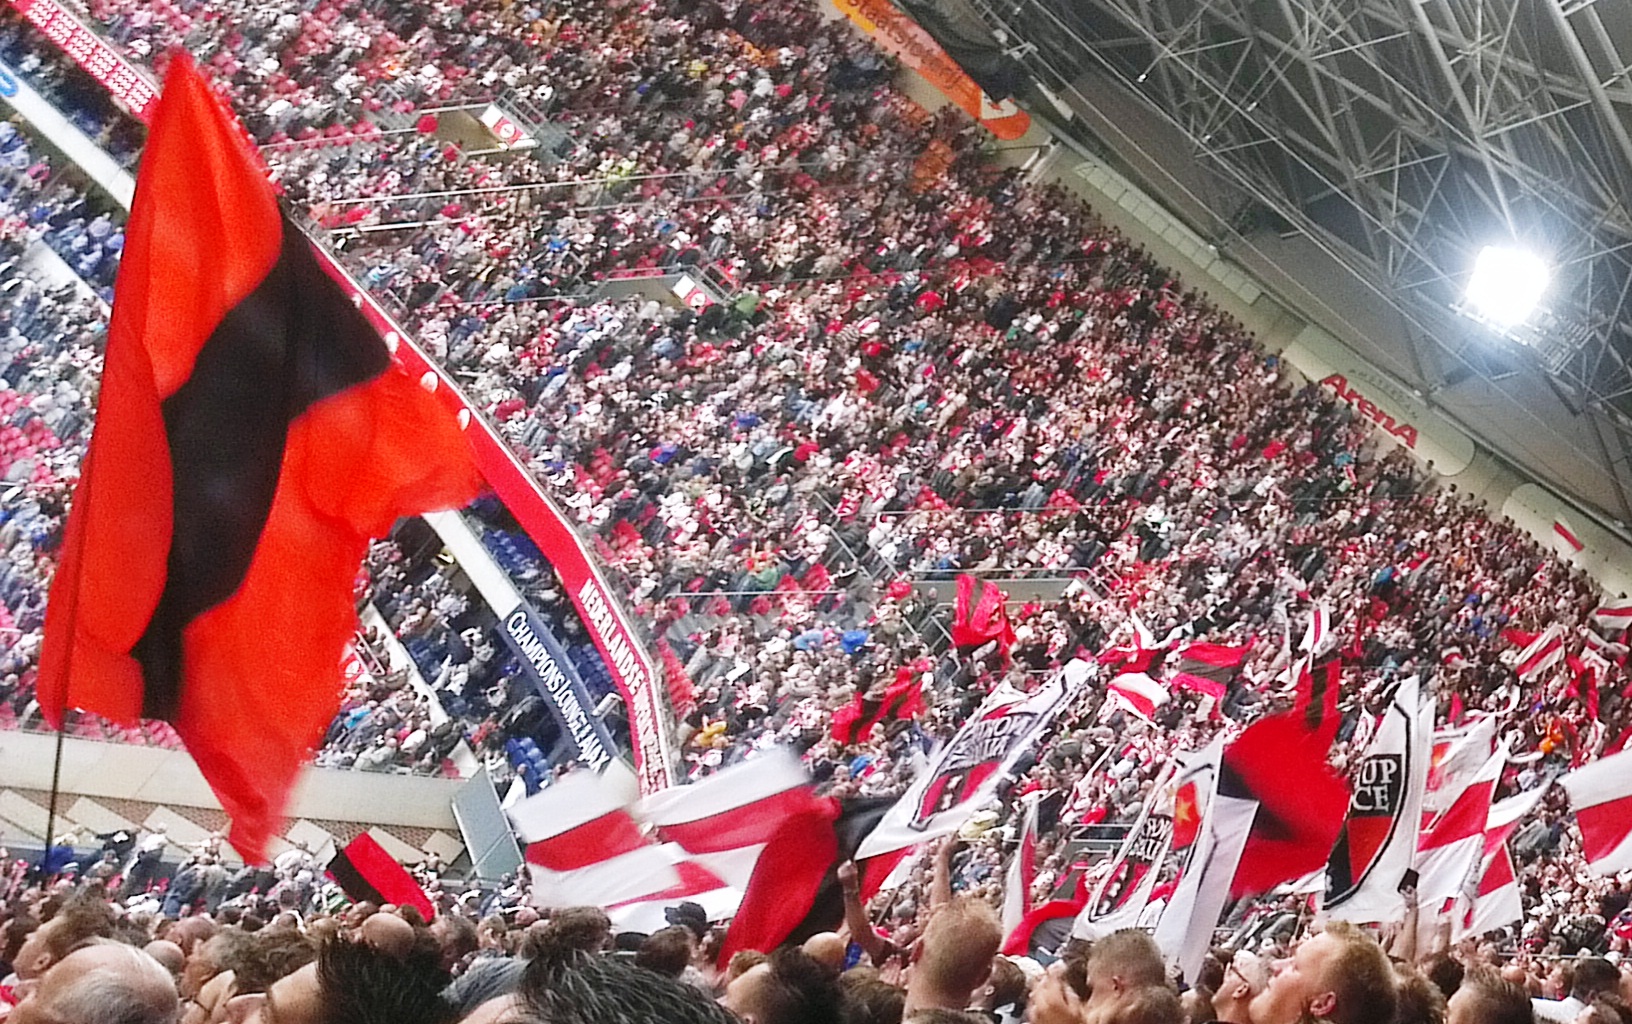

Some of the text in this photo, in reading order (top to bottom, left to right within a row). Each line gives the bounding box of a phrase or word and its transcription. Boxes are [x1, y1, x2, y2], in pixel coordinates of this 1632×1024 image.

[1322, 372, 1418, 449] ArenA
[507, 612, 566, 692] CHAMPIONS
[577, 578, 647, 695] NEDERLANDSE
[1362, 758, 1398, 785] UP
